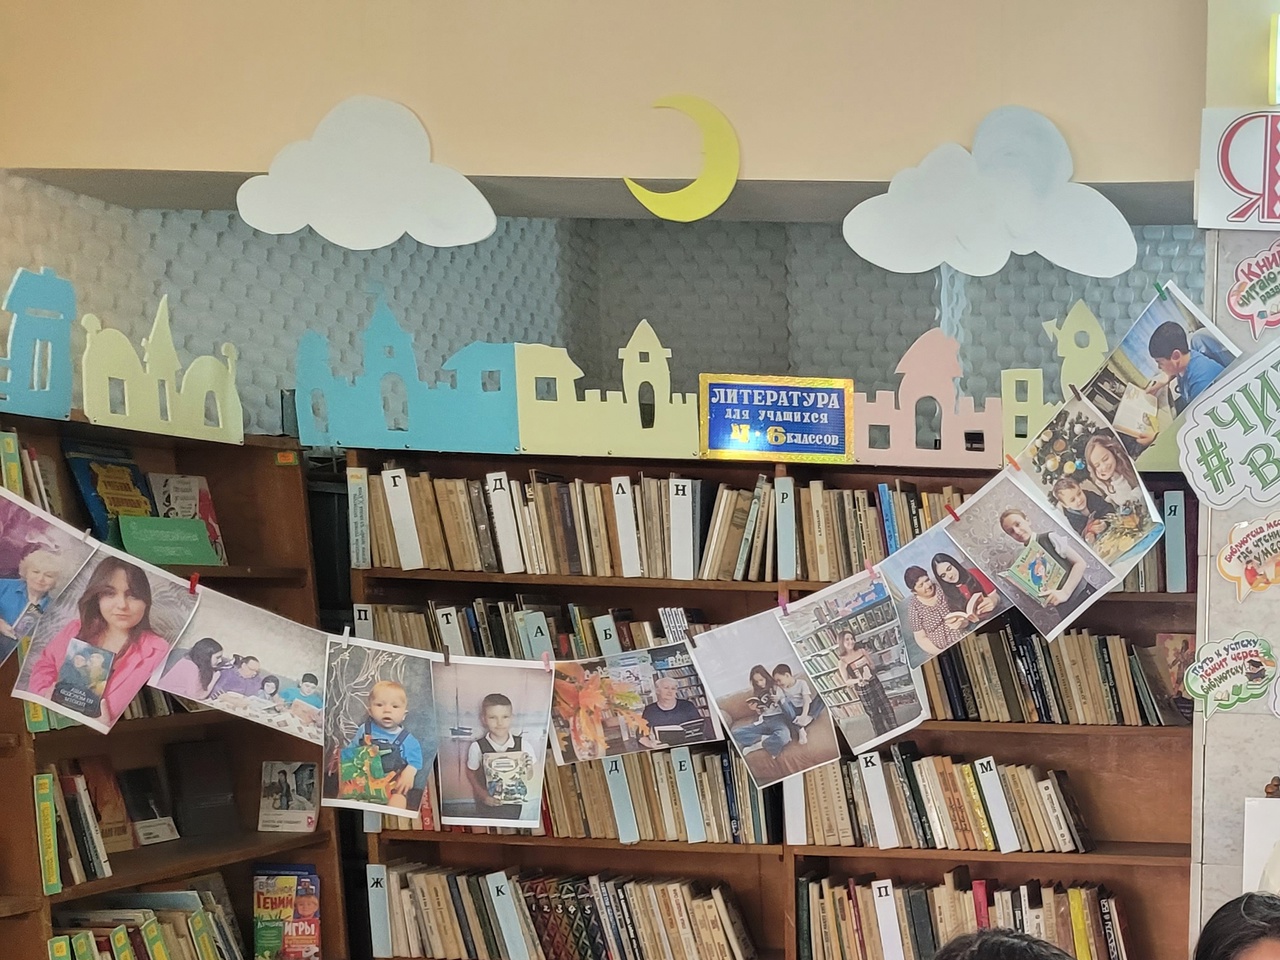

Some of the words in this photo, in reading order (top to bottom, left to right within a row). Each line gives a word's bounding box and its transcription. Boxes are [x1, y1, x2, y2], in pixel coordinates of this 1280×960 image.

[711, 388, 840, 409] ЛИТЕРАТУРА
[758, 410, 828, 424] УЧАЩИХСЯ
[390, 475, 401, 487] Г
[492, 478, 506, 491] Д
[615, 482, 627, 495] Л
[674, 484, 687, 496] Н
[780, 492, 789, 504] Р
[1166, 504, 1178, 517] Я
[357, 609, 368, 620] П
[441, 612, 452, 625] Т
[534, 625, 544, 637] А
[603, 628, 612, 640] Б
[609, 760, 620, 775] Д
[678, 760, 688, 773] Е
[862, 755, 877, 768] К
[979, 760, 994, 773] М
[370, 877, 383, 888] Ж
[495, 885, 505, 897] К
[877, 885, 890, 897] П
[284, 921, 315, 936] ИГРЫ
